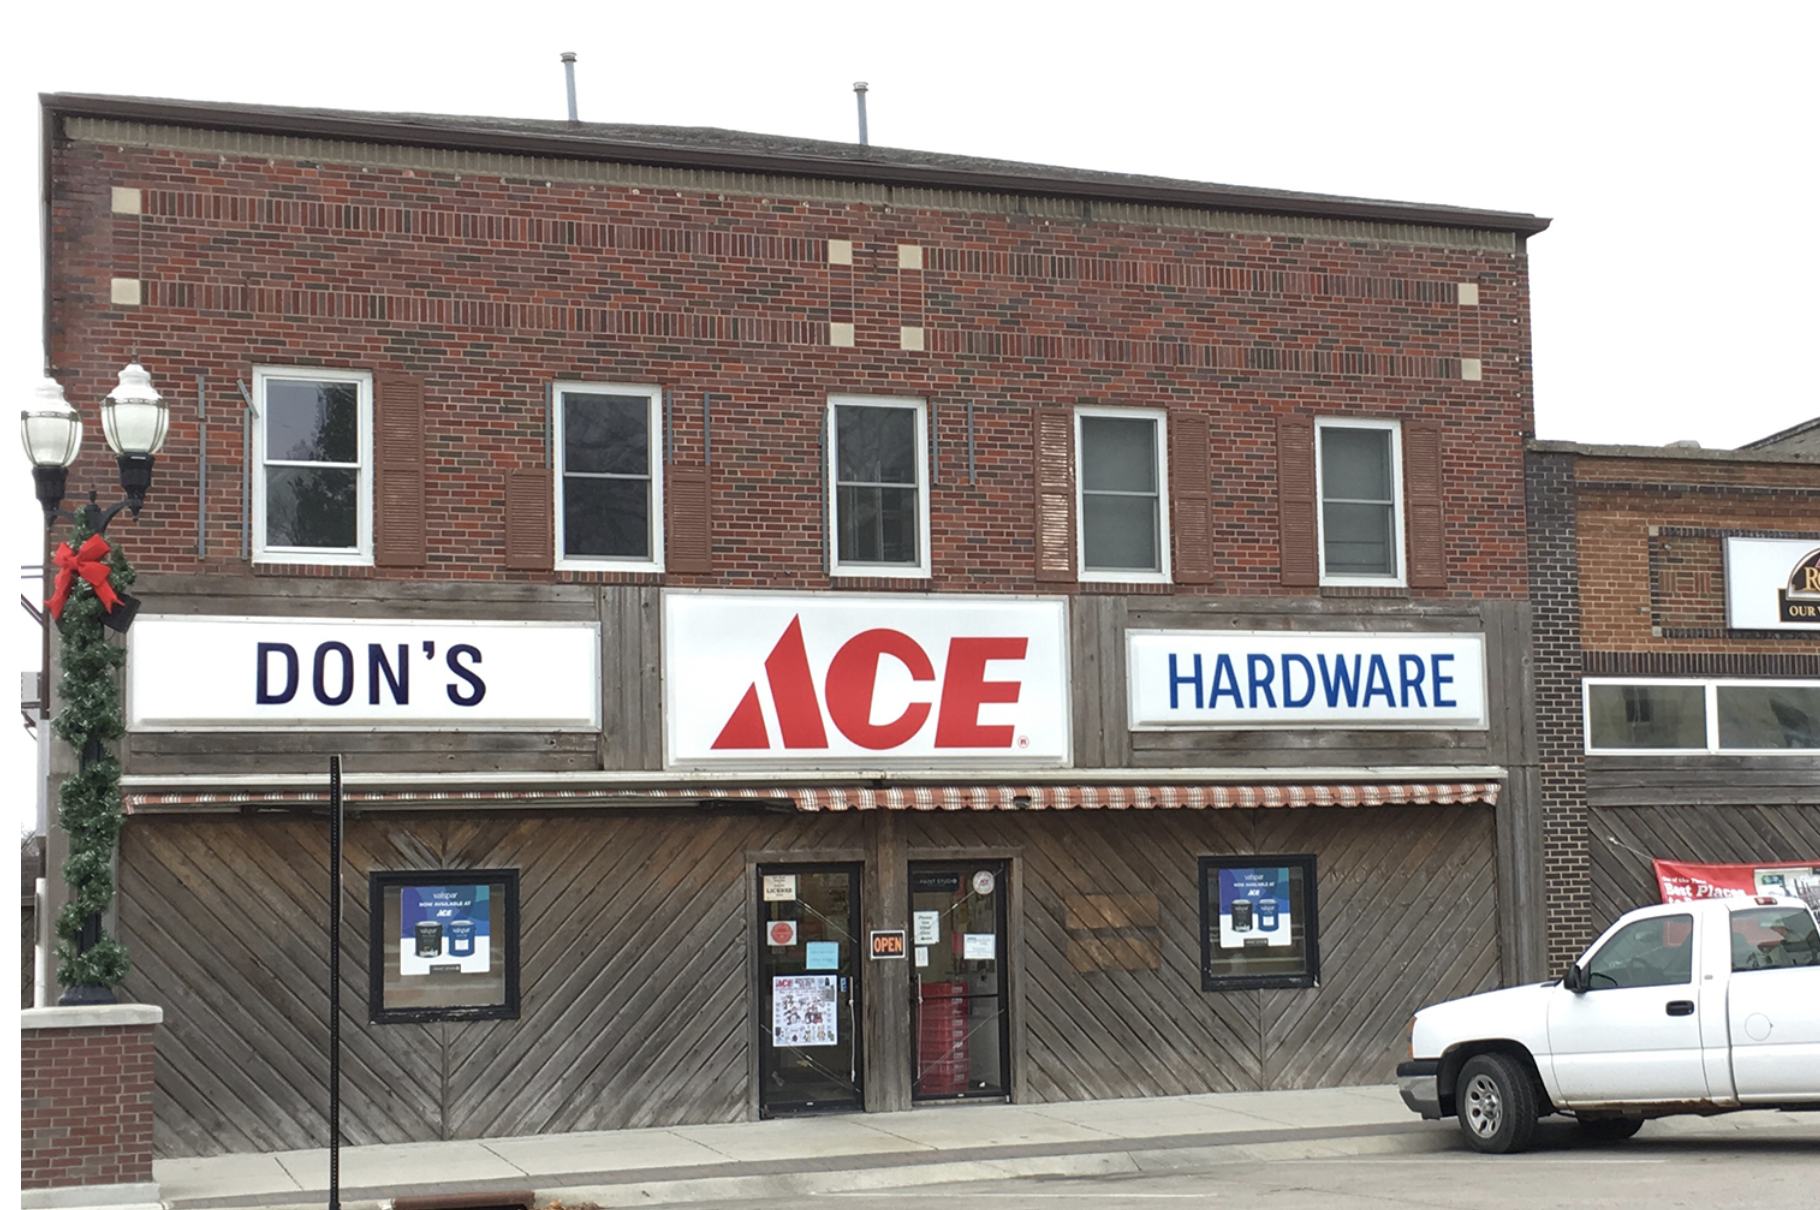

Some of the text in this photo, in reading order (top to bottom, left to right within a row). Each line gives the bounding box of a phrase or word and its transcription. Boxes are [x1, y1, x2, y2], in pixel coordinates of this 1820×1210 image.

[1802, 567, 1820, 591] R
[1789, 605, 1816, 616] OUR
[256, 640, 487, 707] DON'S
[1168, 653, 1457, 709] HARDWARE
[712, 615, 1029, 749] ACE
[432, 891, 458, 900] valspar
[1664, 882, 1693, 897] Best
[436, 909, 453, 917] ACE
[874, 937, 902, 953] OPEN
